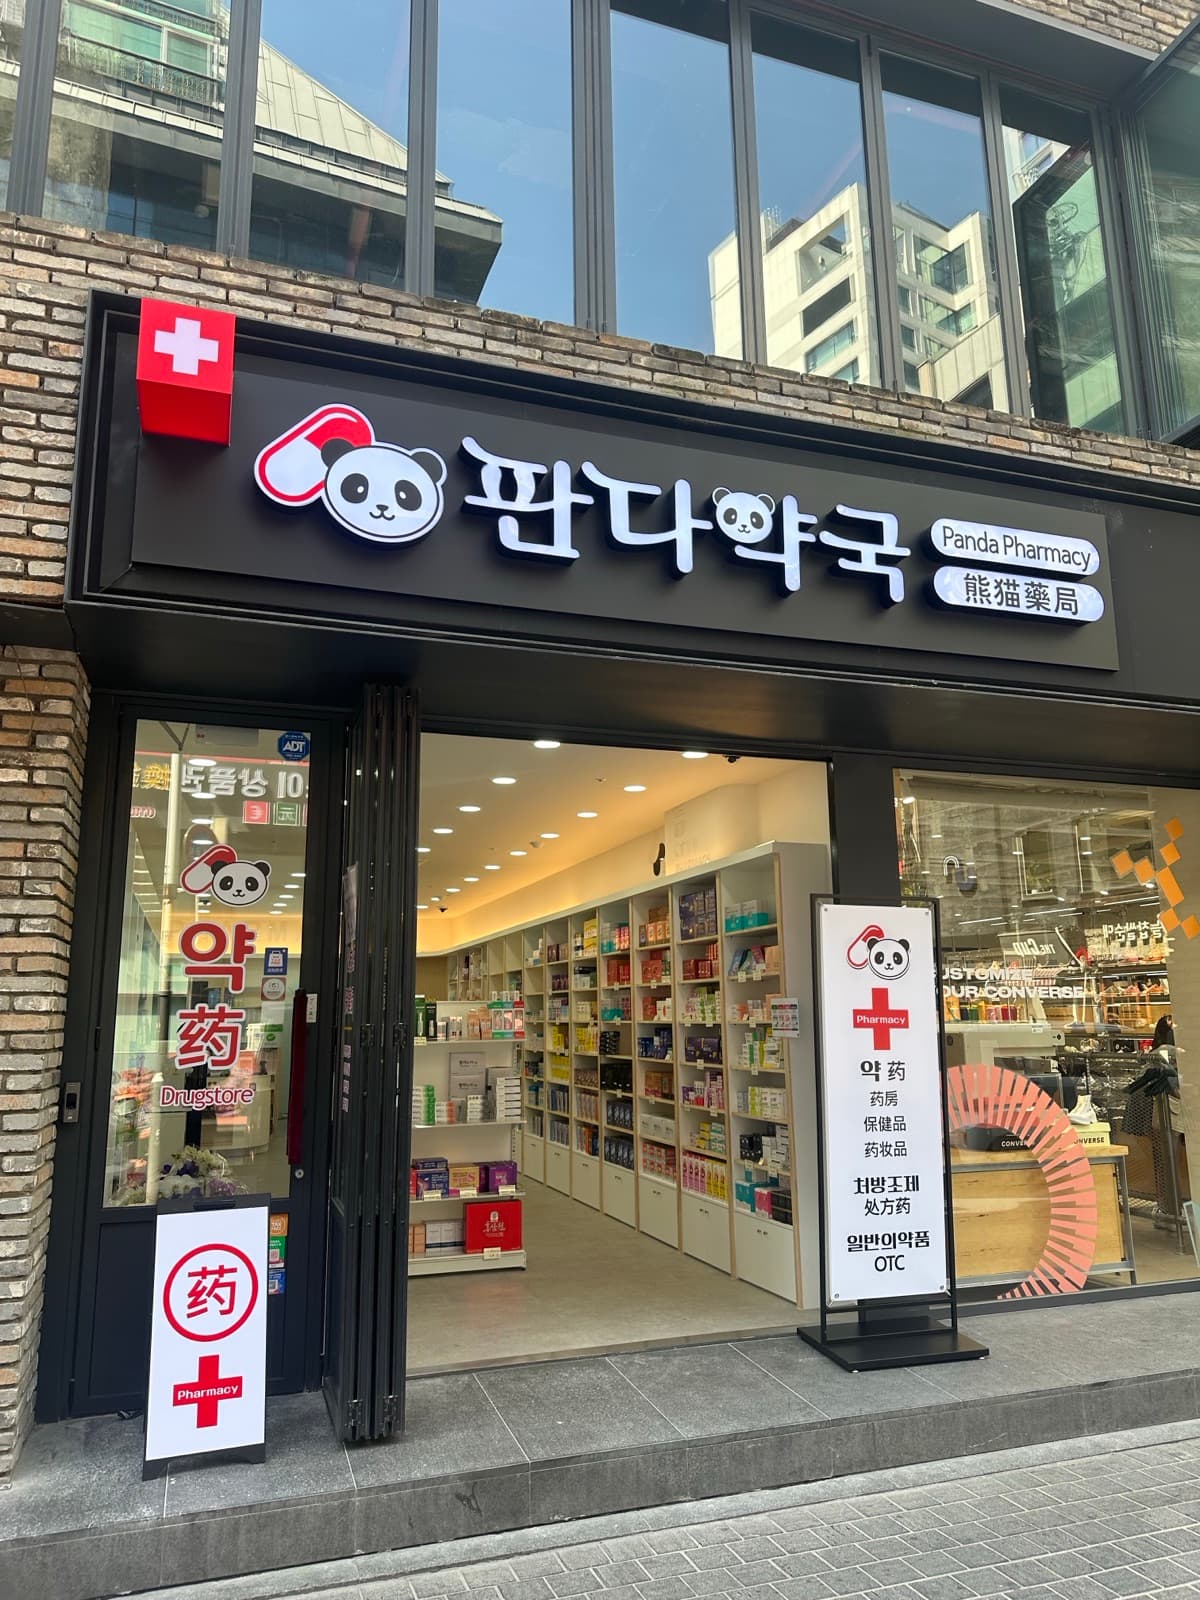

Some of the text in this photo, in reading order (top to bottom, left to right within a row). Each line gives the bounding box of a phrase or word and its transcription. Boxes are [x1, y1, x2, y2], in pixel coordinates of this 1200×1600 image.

[461, 436, 911, 604] 판다약국
[942, 523, 1092, 572] Panda Pharmacy
[963, 571, 1080, 617] 熊猫藥局
[282, 740, 306, 753] ADT
[180, 923, 256, 993] 약
[942, 967, 1033, 981] USTOMIZE
[943, 985, 1084, 999] OUR CONVERSE
[856, 1013, 907, 1027] Pharmacy
[177, 1004, 244, 1069] 药
[860, 1060, 906, 1082] 약 药
[161, 1086, 254, 1110] Drugstore
[869, 1090, 899, 1107] 药房
[863, 1115, 907, 1133] 保健品
[864, 1140, 907, 1158] 药妆品
[853, 1174, 920, 1196] 처방조제
[864, 1196, 911, 1216] 处方药
[846, 1230, 930, 1253] 일반의약품
[874, 1254, 905, 1272] OTC
[186, 1265, 238, 1319] 药
[177, 1381, 240, 1401] Pharmacy
